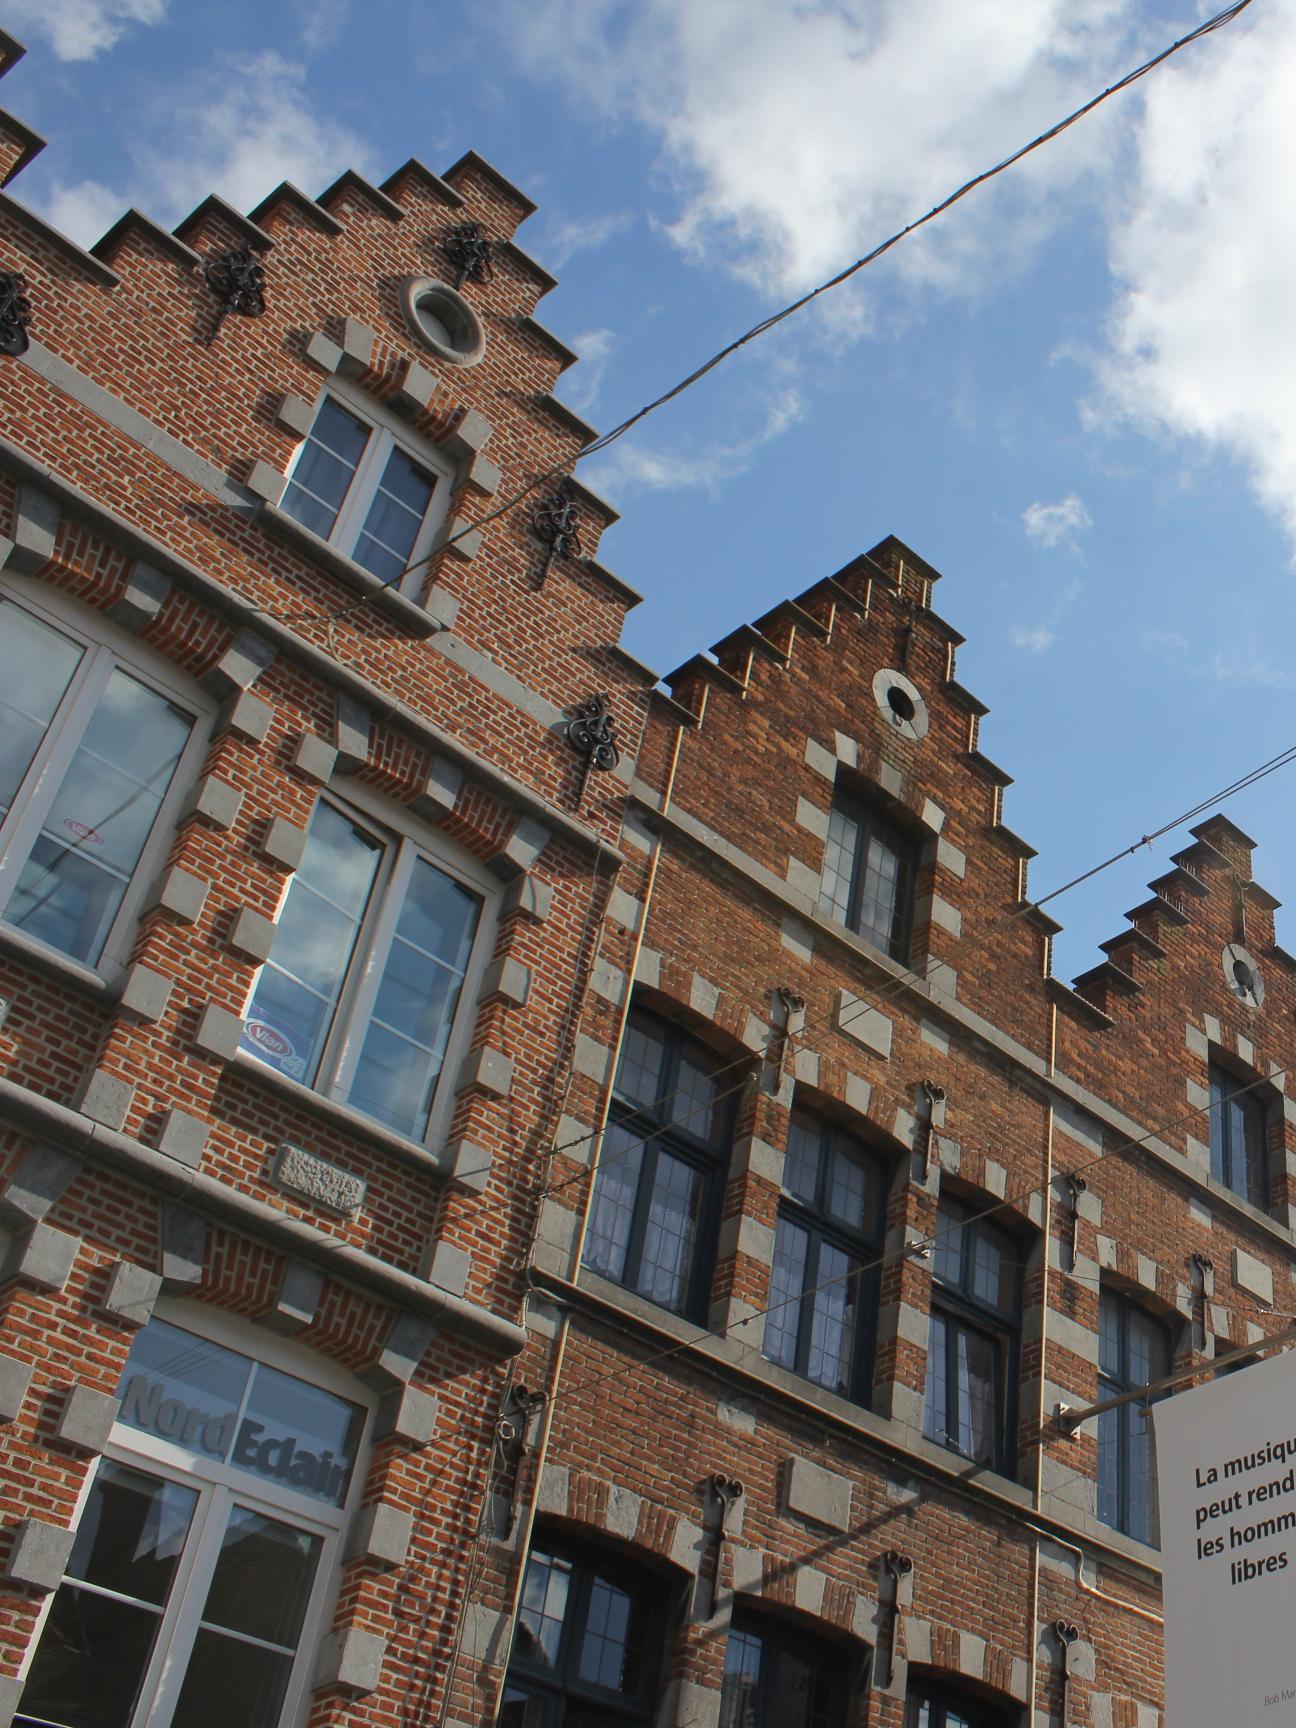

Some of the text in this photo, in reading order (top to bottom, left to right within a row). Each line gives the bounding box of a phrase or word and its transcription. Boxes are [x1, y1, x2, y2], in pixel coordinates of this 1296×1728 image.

[255, 1027, 284, 1051] Vlan
[119, 1373, 241, 1458] Nord
[1195, 1467, 1218, 1489] La
[1195, 1490, 1243, 1530] peut
[1196, 1536, 1225, 1560] les
[1230, 1551, 1289, 1585] libres
[1264, 1694, 1280, 1705] Bob
